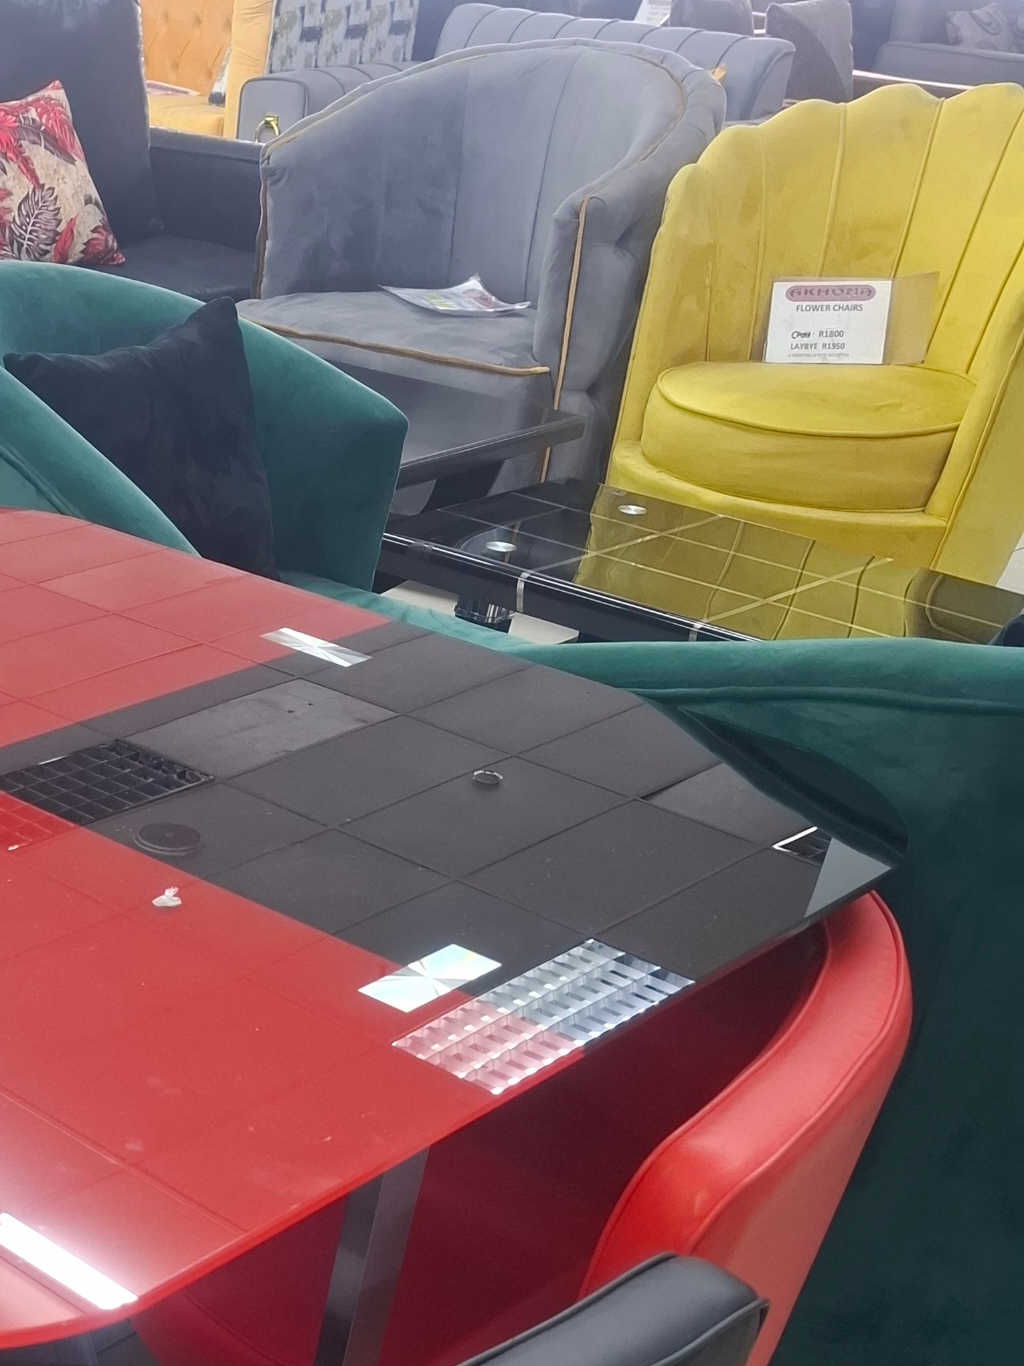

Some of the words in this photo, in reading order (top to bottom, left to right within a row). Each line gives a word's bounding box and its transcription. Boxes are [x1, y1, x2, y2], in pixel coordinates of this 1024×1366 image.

[796, 304, 831, 312] FLOWER
[832, 304, 864, 312] CHAIRS
[818, 330, 845, 338] R1800
